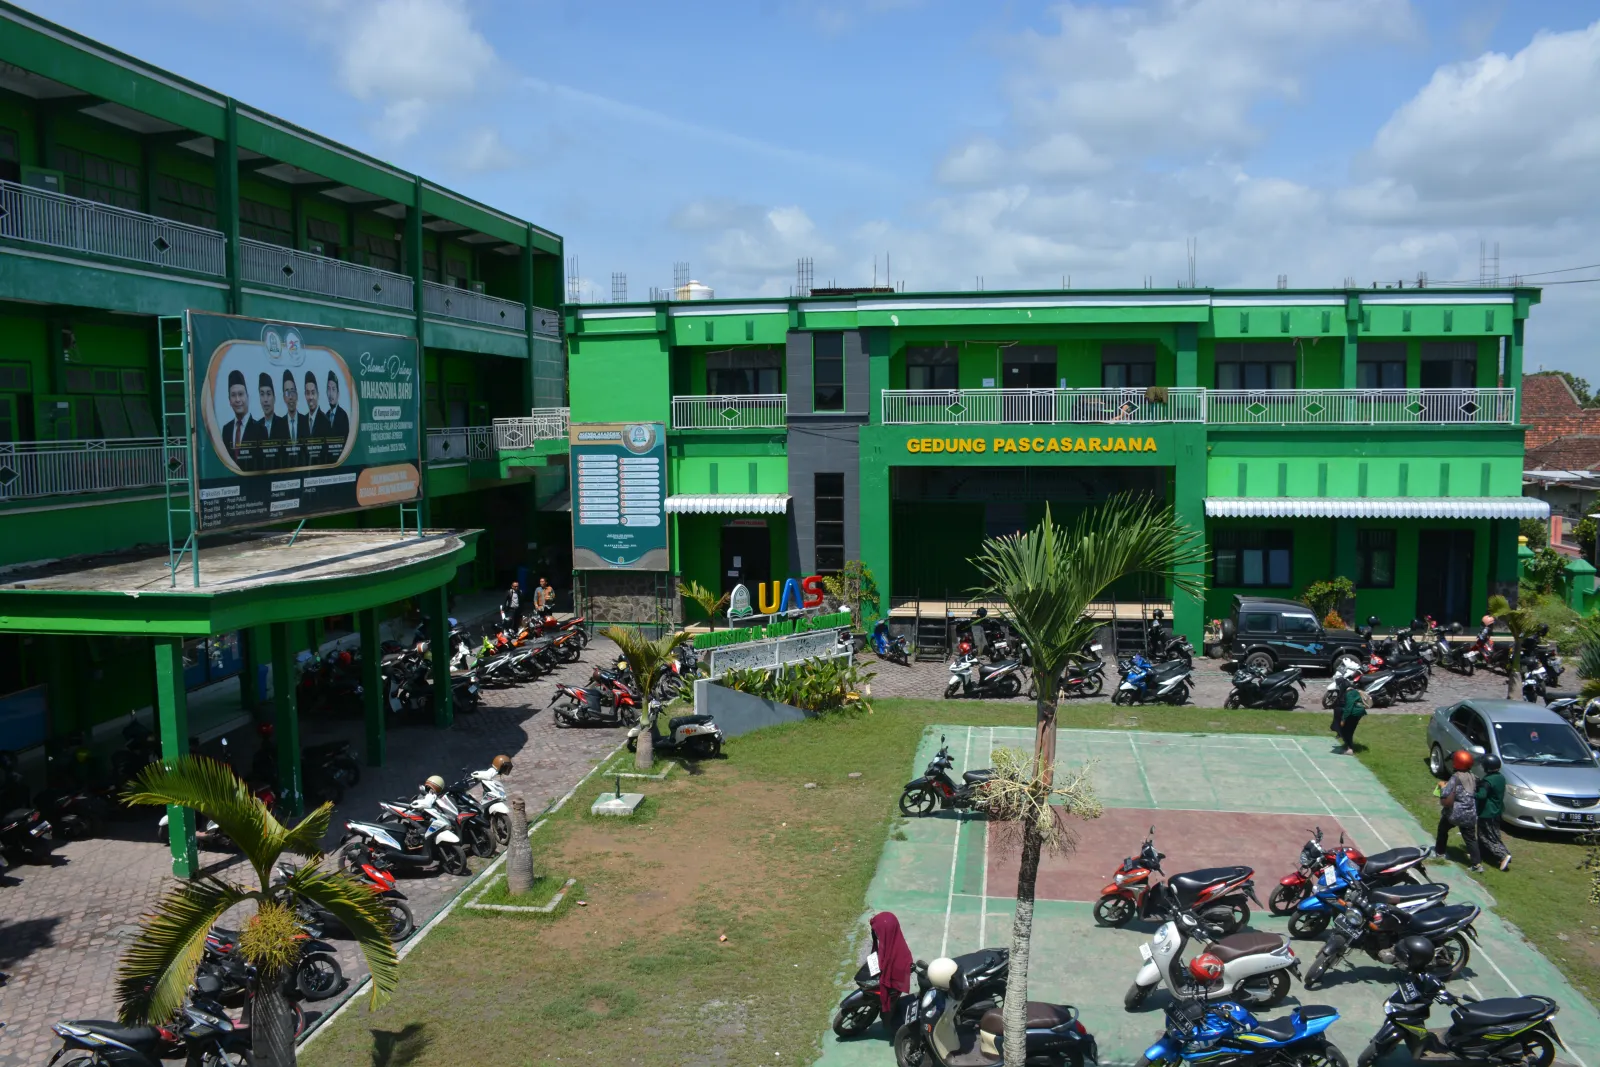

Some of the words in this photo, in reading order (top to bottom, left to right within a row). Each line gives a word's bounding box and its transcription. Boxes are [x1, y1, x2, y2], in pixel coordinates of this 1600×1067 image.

[360, 352, 387, 376] Selamat
[387, 355, 412, 381] Datang
[361, 381, 397, 399] MAHASISWA
[398, 382, 412, 399] BARU
[907, 438, 985, 453] GEDUNG
[993, 437, 1157, 453] PASCASARJANA
[758, 575, 824, 616] UAS
[693, 627, 750, 650] UNIVERSITAS
